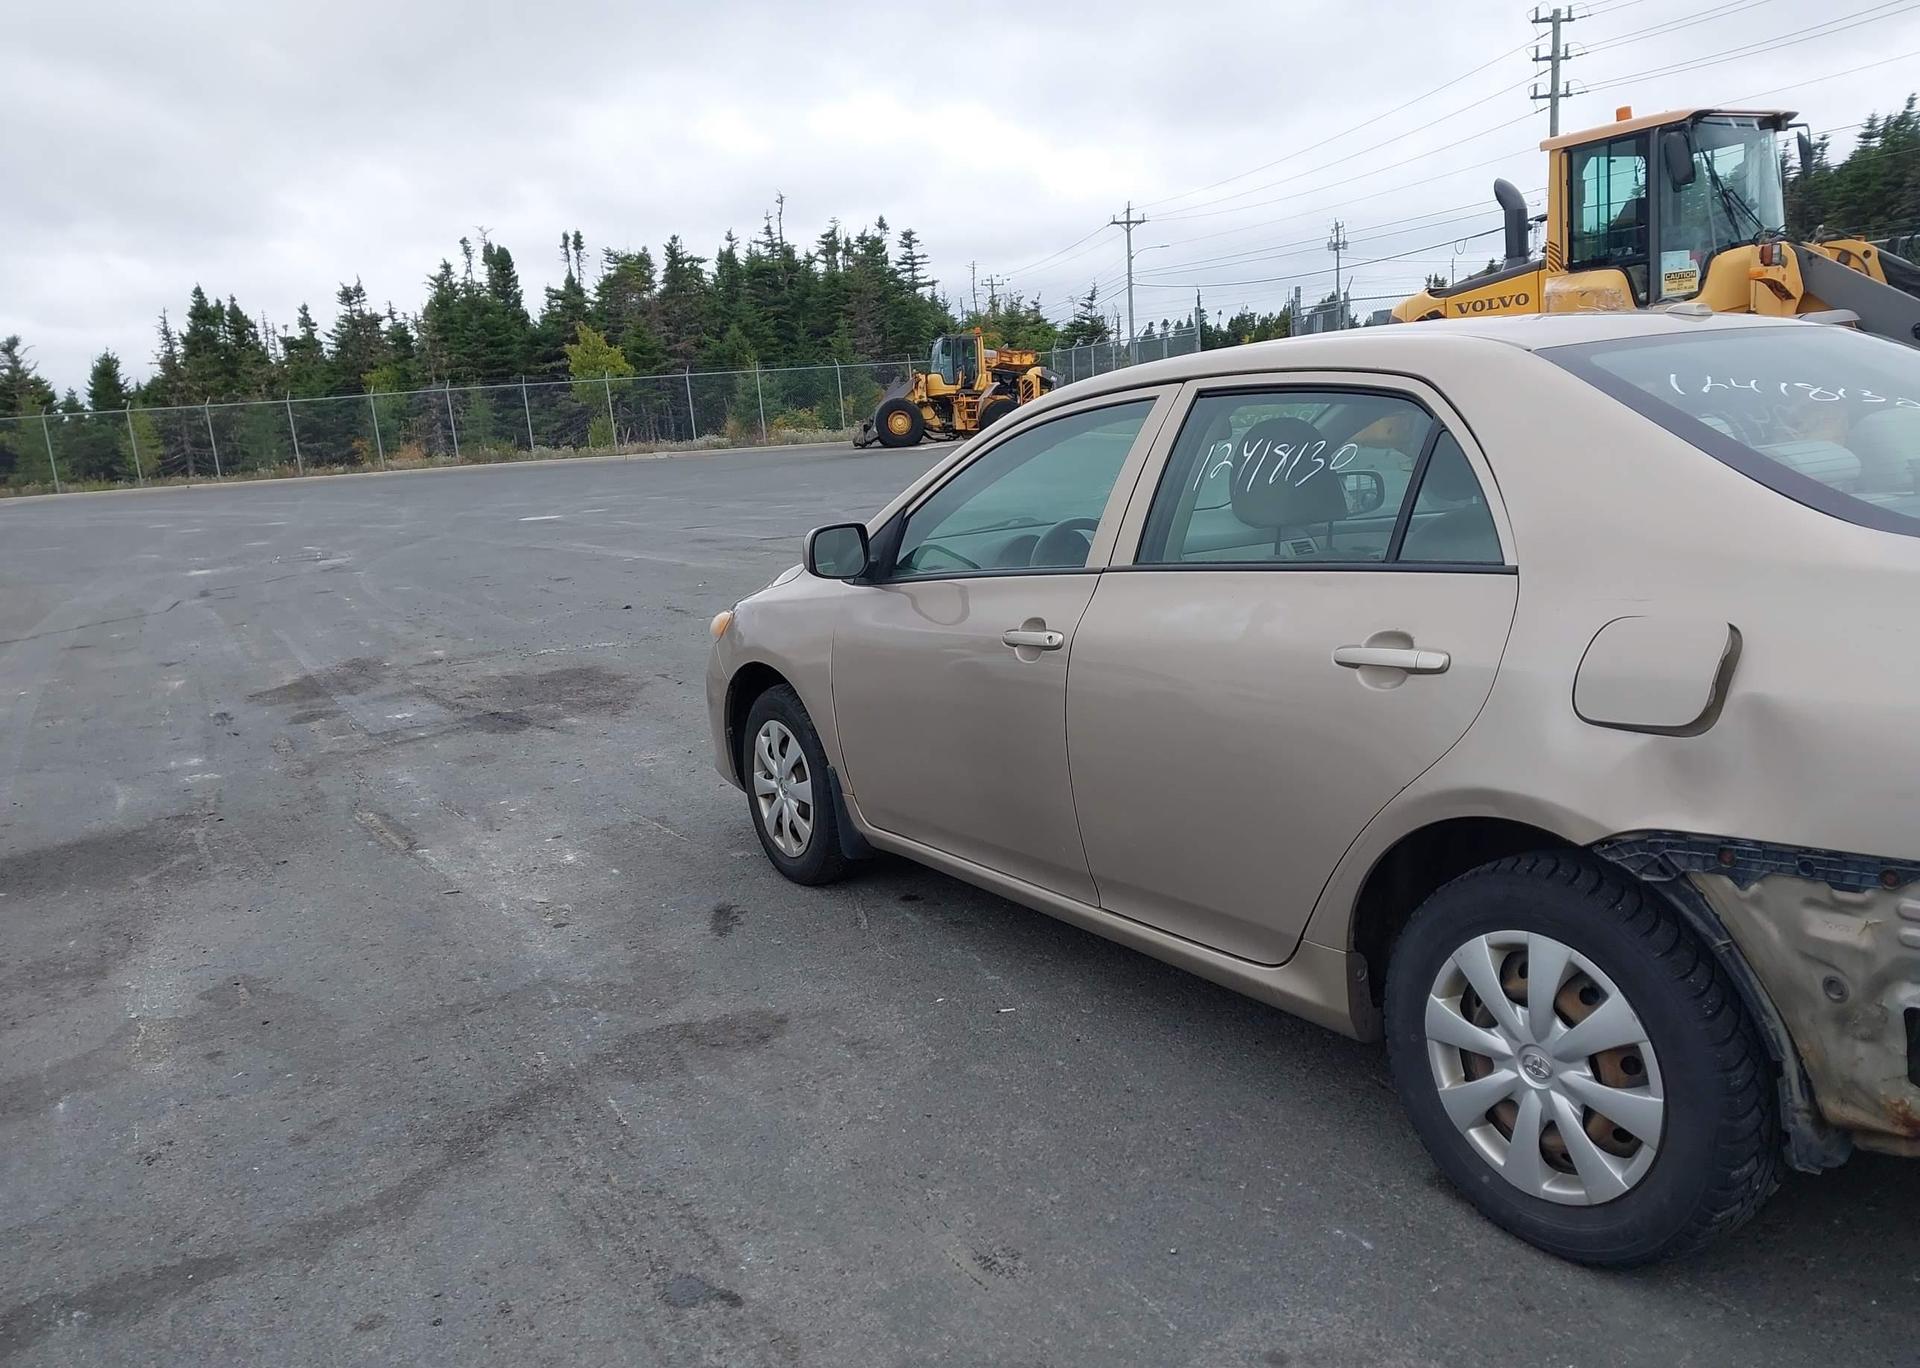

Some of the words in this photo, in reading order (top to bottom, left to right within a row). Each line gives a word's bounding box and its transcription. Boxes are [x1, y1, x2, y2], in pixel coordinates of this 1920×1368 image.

[1665, 271, 1696, 280] CAUTION
[1455, 293, 1529, 314] VOLVO
[1193, 438, 1358, 492] 12418130
